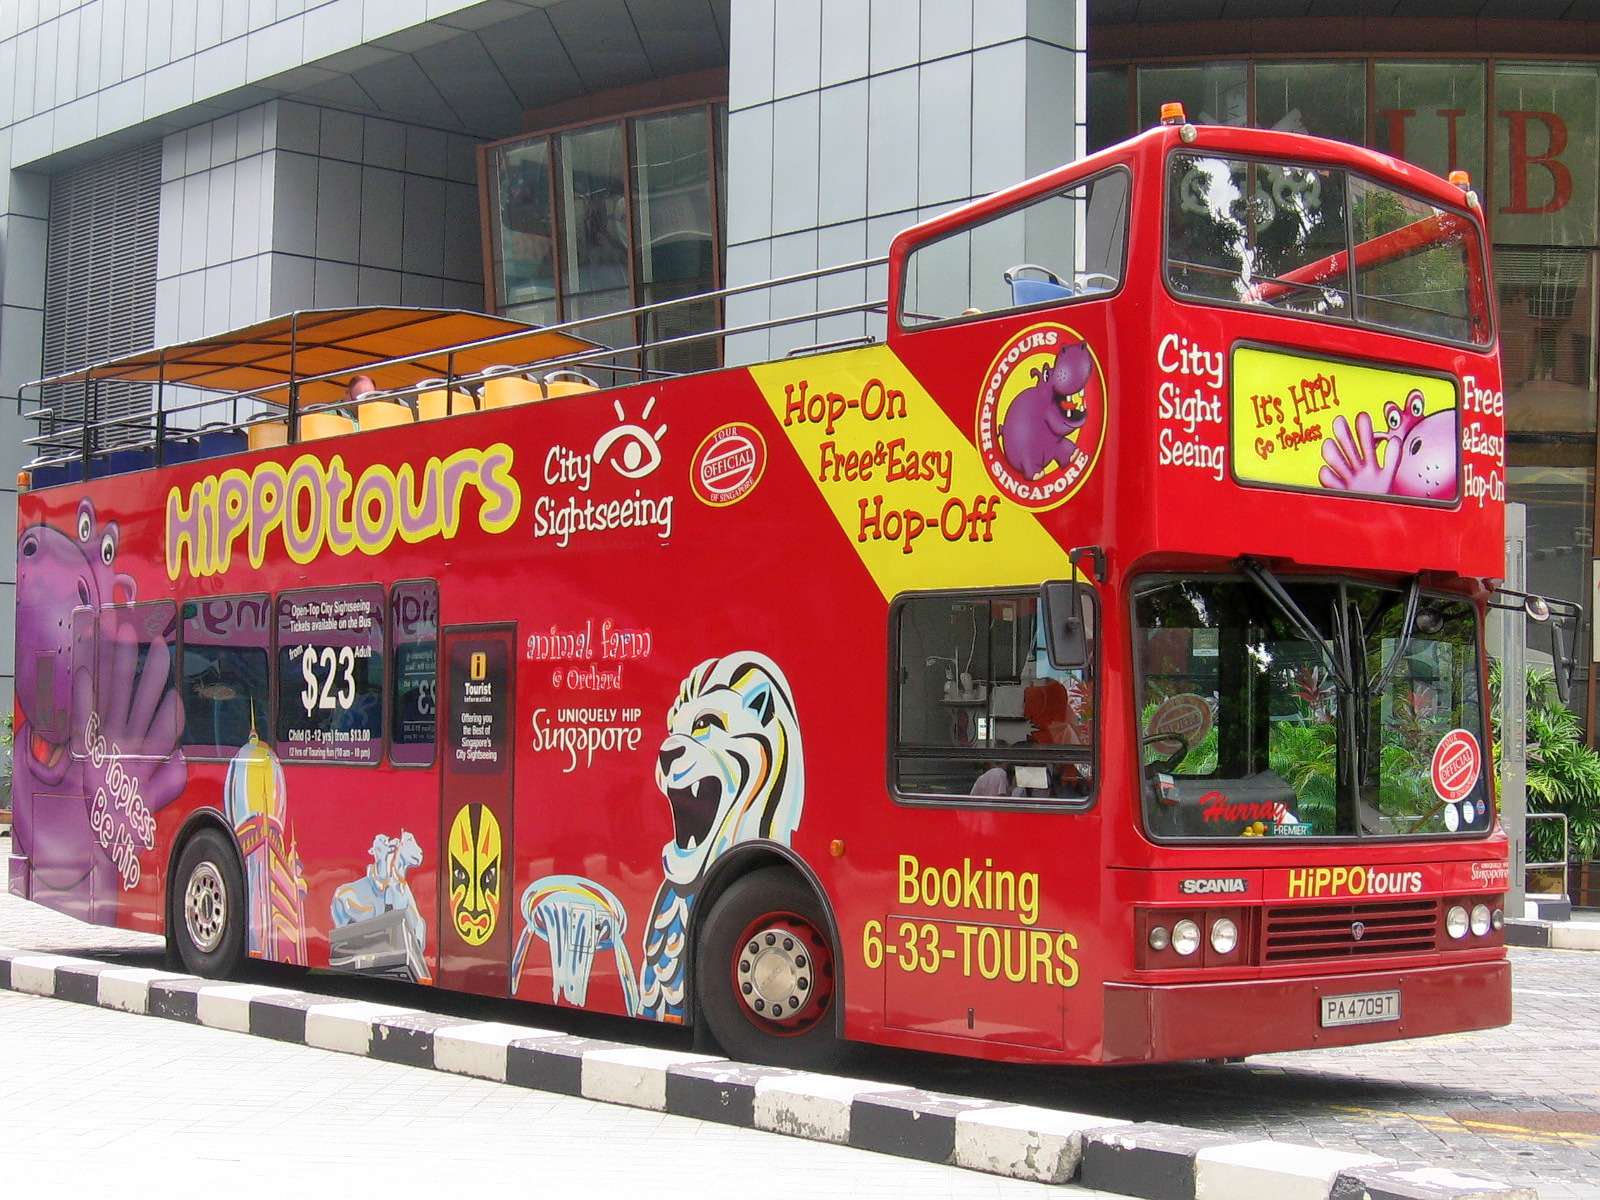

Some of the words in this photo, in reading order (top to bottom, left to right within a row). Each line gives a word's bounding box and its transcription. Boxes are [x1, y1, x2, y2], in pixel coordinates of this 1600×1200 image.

[1157, 333, 1224, 389] City
[784, 379, 907, 435] Hop-On
[981, 331, 1058, 452] HIPPOTOURS
[1158, 382, 1223, 433] Sight
[1462, 376, 1504, 417] Free
[713, 427, 738, 443] TOUR
[1159, 428, 1224, 481] Seeing
[1254, 436, 1275, 460] Go
[1276, 423, 1323, 451] Topless
[1462, 423, 1504, 466] &Easy
[543, 444, 591, 491] City
[704, 450, 753, 479] OFFICIAL
[991, 452, 1089, 500] SINGAPORE
[1464, 464, 1505, 508] Hop-On
[534, 488, 674, 548] Sightseeing
[858, 495, 1000, 554] Hop-Off
[290, 620, 311, 632] Tickets
[311, 617, 337, 631] available
[338, 618, 347, 629] on
[348, 615, 358, 628] the
[358, 615, 372, 628] Bus
[320, 601, 333, 616] City
[334, 599, 371, 616] Sightseeing
[527, 619, 593, 660] animal
[601, 618, 652, 659] farm
[288, 645, 303, 660] from
[301, 643, 356, 717] $23
[354, 645, 372, 658] Adult
[464, 683, 492, 695] Tourist
[566, 664, 622, 690] Orchard
[461, 713, 482, 725] Offering
[482, 715, 493, 725] you
[463, 724, 471, 735] the
[472, 724, 485, 735] Best
[484, 724, 491, 735] of
[558, 708, 617, 725] UNIQUELY
[621, 708, 642, 723] HIP
[288, 729, 304, 741] Child
[322, 729, 334, 744] yrs)
[335, 729, 349, 741] from
[350, 729, 371, 743] $13.00
[456, 749, 466, 761] City
[466, 749, 498, 762] Sightseeing
[461, 737, 492, 749] Singapore's
[532, 708, 642, 773] Singapore
[1441, 750, 1472, 780] OFFICIAL
[106, 743, 157, 850] Topless
[1199, 790, 1288, 827] Hurray
[91, 787, 114, 848] Be
[1273, 825, 1307, 836] PREMIER
[899, 854, 1039, 925] Booking
[1183, 878, 1245, 894] SCANIA
[1288, 866, 1422, 898] HiPPOtours
[863, 920, 1079, 987] 6-33-TOURS
[1328, 996, 1393, 1020] PA4709T
